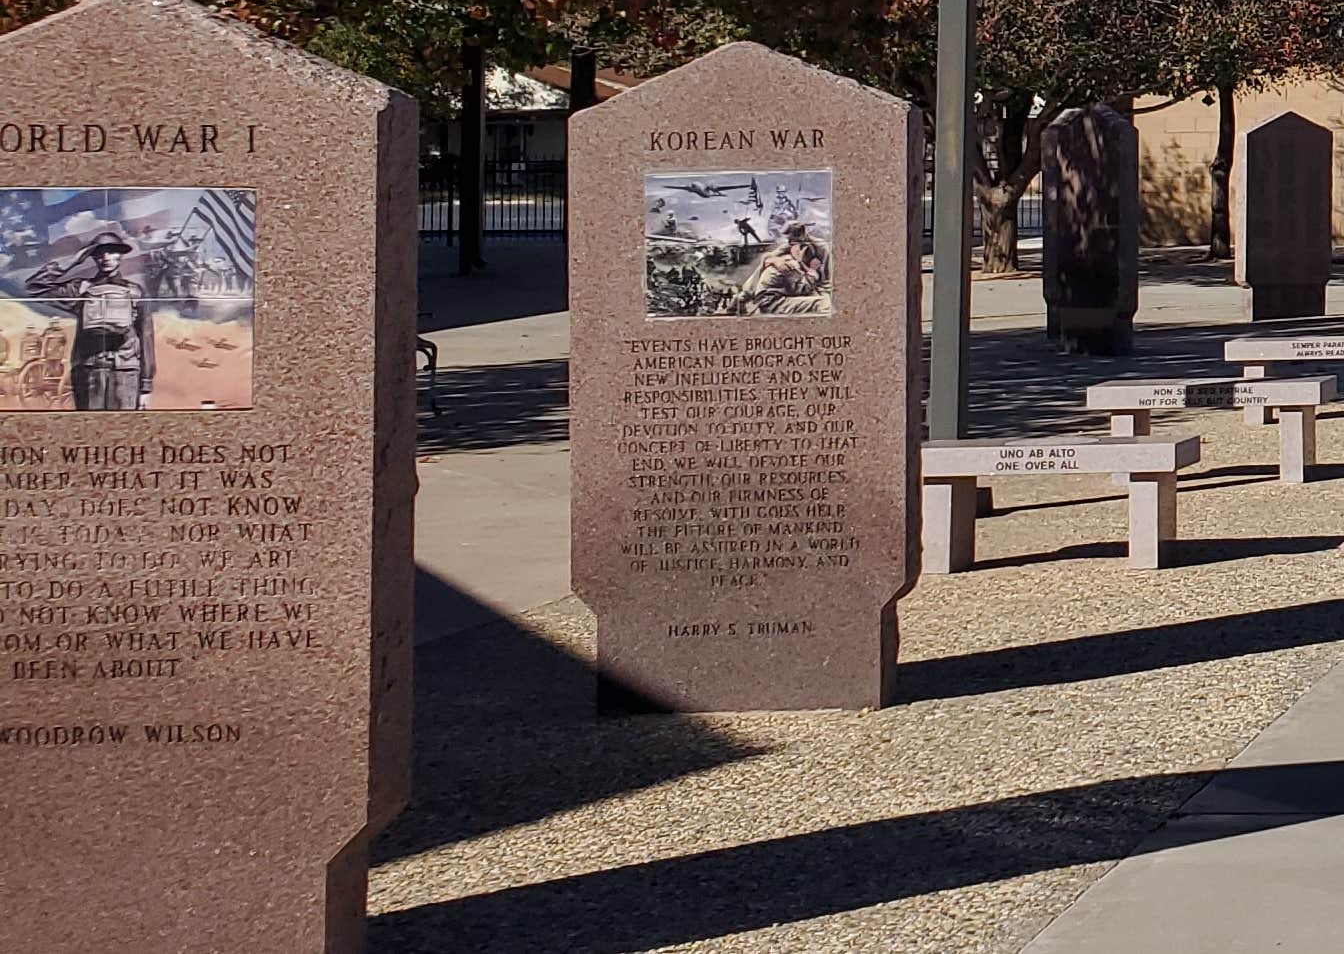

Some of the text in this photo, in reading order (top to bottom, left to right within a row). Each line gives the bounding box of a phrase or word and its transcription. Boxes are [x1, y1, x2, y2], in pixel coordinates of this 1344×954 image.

[0, 123, 259, 153] ORLD WAR I
[649, 129, 825, 151] KOREAN WAR
[698, 336, 851, 351] HAVE BROUGHT OUR
[634, 353, 844, 369] AMERICAN DEMOCRACY TO
[634, 369, 843, 386] NEW INFLUENCE AND NEW
[768, 386, 855, 400] THEY WILL
[1153, 387, 1173, 395] NON
[1139, 398, 1156, 406] NOT
[1160, 398, 1177, 406] FOR
[641, 404, 836, 419] TEST OUR OUR
[623, 420, 854, 437] DEVOTION TO AND OUR
[618, 436, 858, 454] CONCEPT OF LIBERTY TO THAT
[1000, 448, 1076, 458] UNO AB ALTO
[61, 445, 146, 464] WHICH
[161, 445, 226, 464] DOES
[240, 445, 293, 464] NOT
[674, 454, 845, 469] WE WILL OUR
[995, 460, 1079, 471] ONE OVER ALL
[88, 470, 274, 490] WHAT IT WAS
[650, 487, 829, 504] AND OUR OF
[160, 496, 303, 516] NOT KNOW
[238, 523, 314, 543] WHAT
[199, 550, 234, 568] WE
[50, 580, 83, 599] DO
[20, 603, 269, 624] NOT KNOW WHERE
[56, 629, 322, 652] OR WHAT WE HAVE
[145, 723, 241, 745] WILSON
